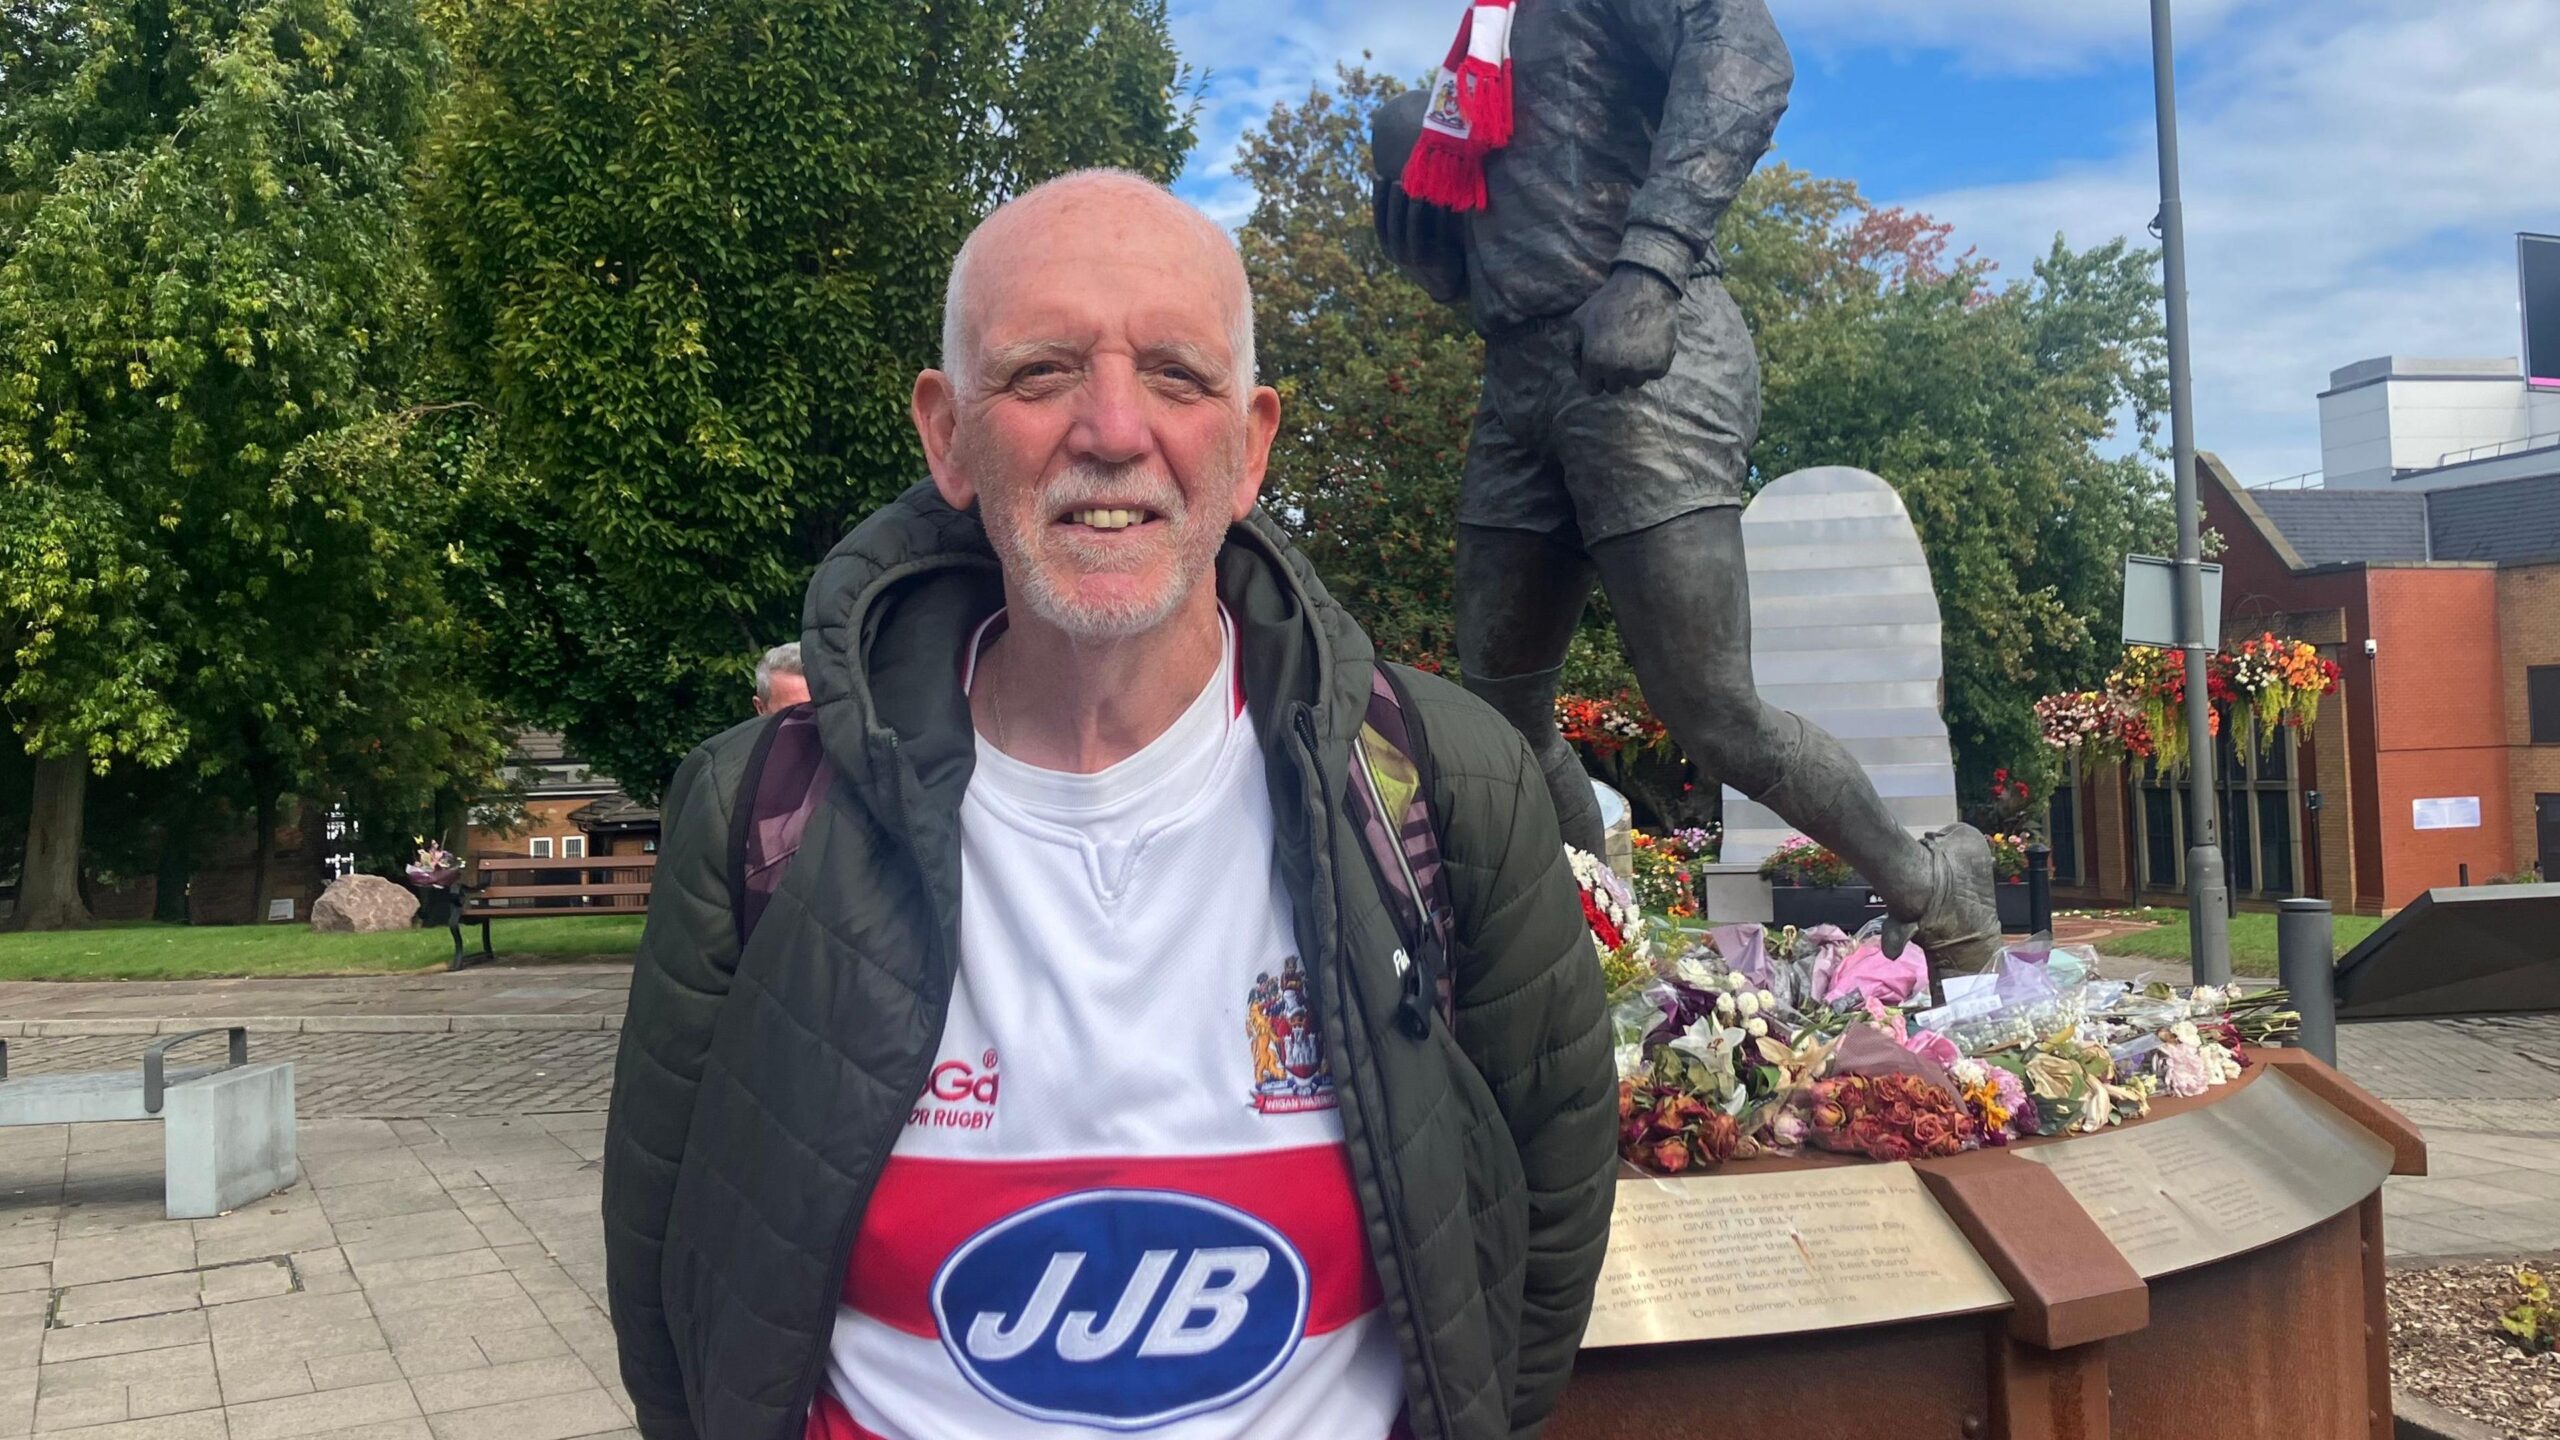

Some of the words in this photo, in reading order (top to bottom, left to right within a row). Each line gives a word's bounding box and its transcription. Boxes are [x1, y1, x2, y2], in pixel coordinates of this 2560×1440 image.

[1264, 1097, 1298, 1110] WIGAN
[906, 1108, 930, 1126] OR
[934, 1108, 994, 1130] RUGBY
[1632, 1213, 1674, 1226] Wigan
[1729, 1206, 1744, 1215] to
[1682, 1221, 1715, 1233] GIVE
[1718, 1219, 1729, 1229] IT
[1735, 1217, 1755, 1228] TO
[1759, 1214, 1794, 1226] BILLY
[1659, 1276, 1685, 1289] DW
[965, 1246, 1270, 1363] JJB
